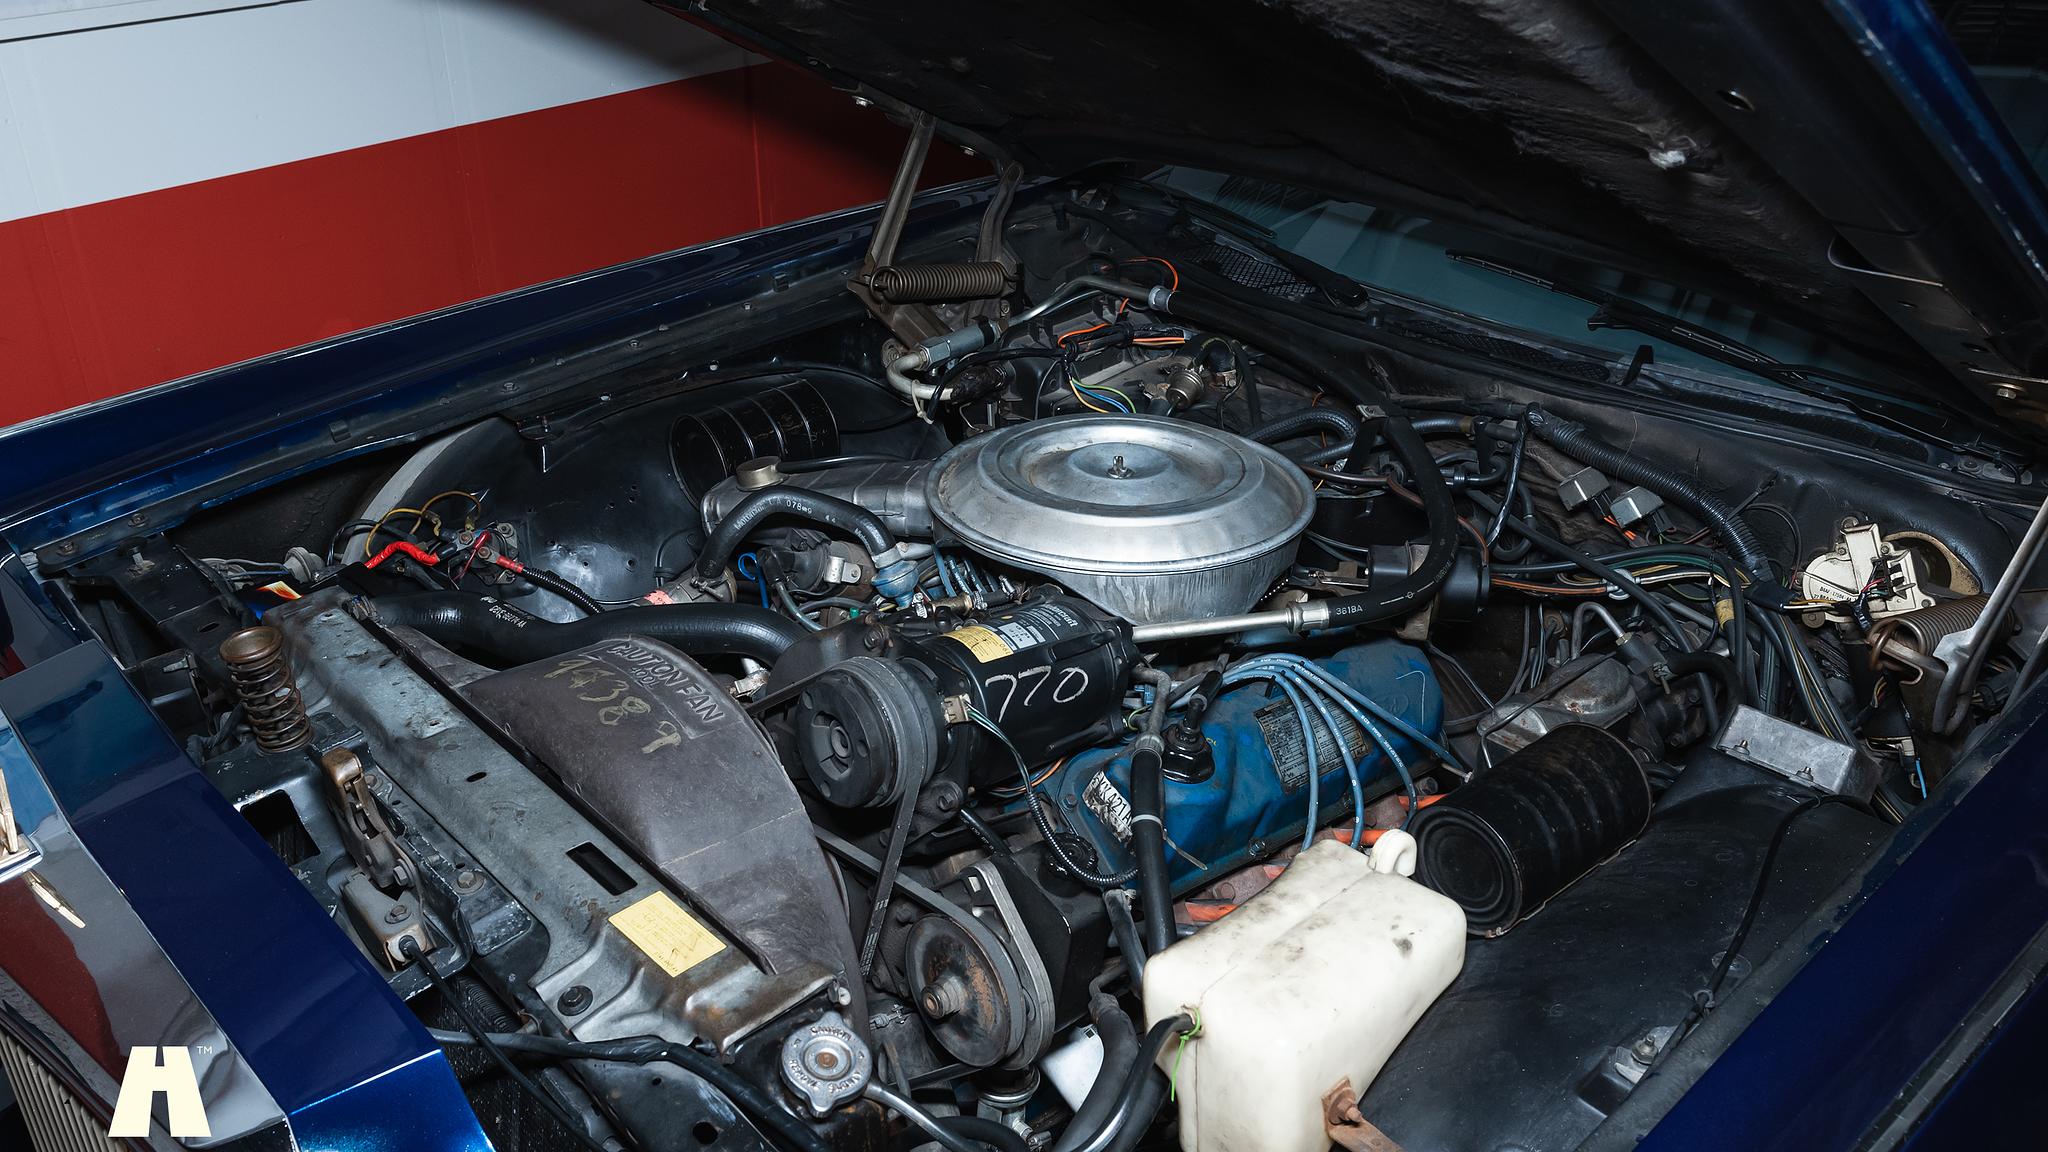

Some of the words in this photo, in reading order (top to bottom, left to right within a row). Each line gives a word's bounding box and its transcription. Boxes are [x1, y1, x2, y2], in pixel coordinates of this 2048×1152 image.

[1335, 604, 1363, 616] 3618A
[606, 642, 689, 687] CAUTION
[676, 682, 726, 723] FAN
[985, 665, 1090, 724] 770
